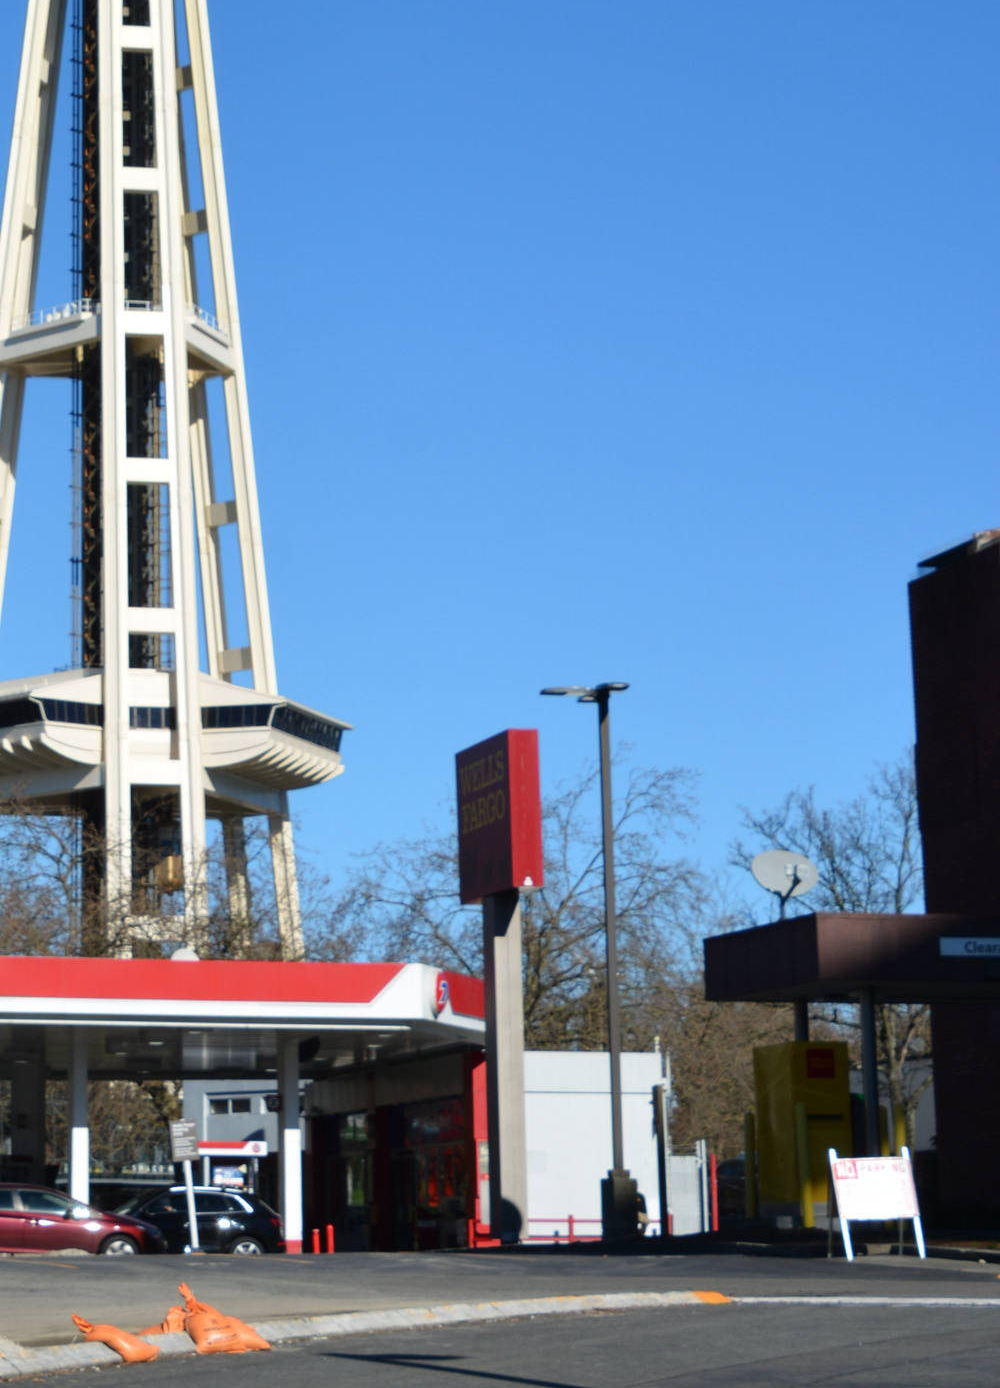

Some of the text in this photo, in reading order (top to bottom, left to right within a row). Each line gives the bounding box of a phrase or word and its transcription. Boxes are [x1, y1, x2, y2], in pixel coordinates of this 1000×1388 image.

[459, 749, 505, 796] WELLS
[462, 788, 506, 834] FARGO
[964, 940, 1000, 954] Clear
